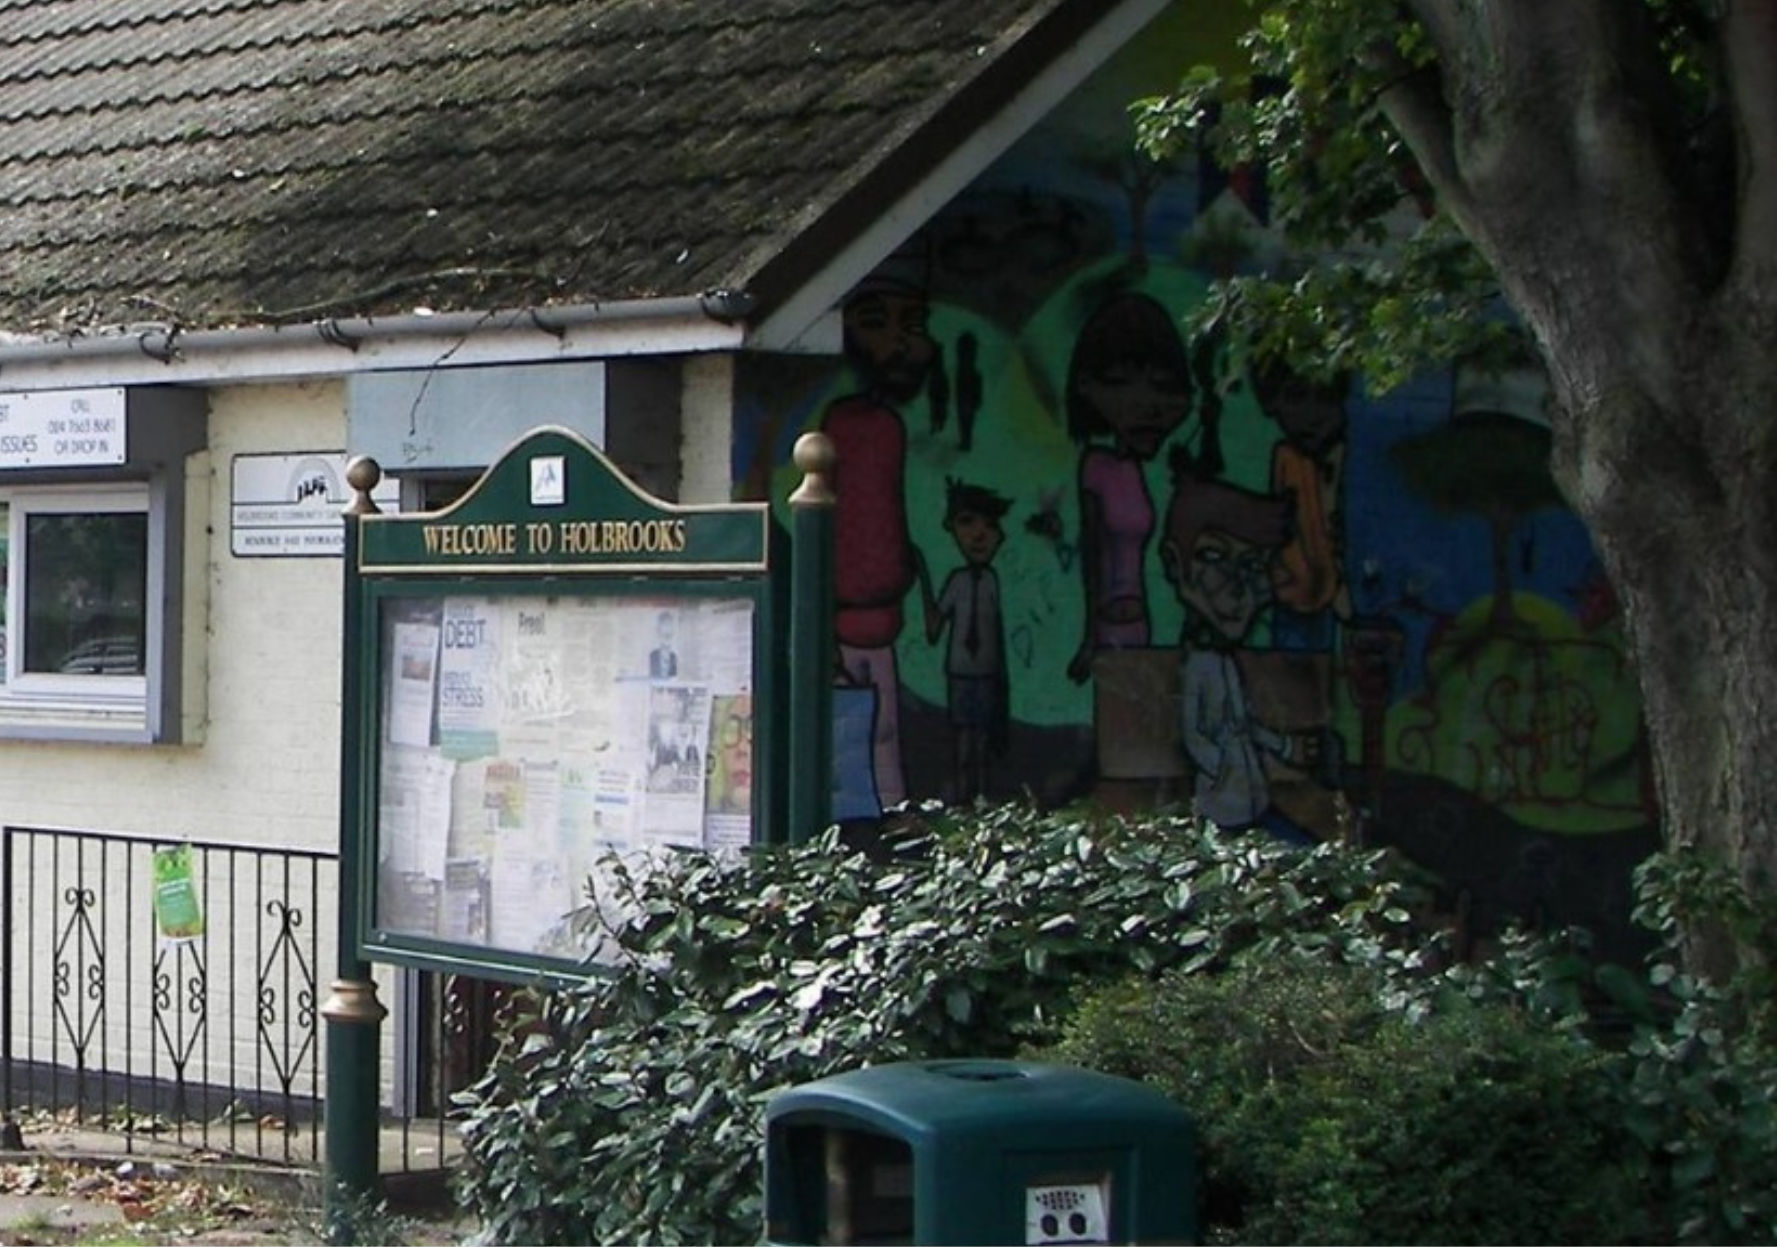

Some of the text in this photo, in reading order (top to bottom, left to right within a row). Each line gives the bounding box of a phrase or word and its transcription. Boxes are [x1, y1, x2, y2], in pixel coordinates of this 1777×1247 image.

[0, 434, 38, 453] ISSUES
[423, 520, 686, 555] WELCOME TO HOLBROOKS
[444, 618, 487, 649] DEBT
